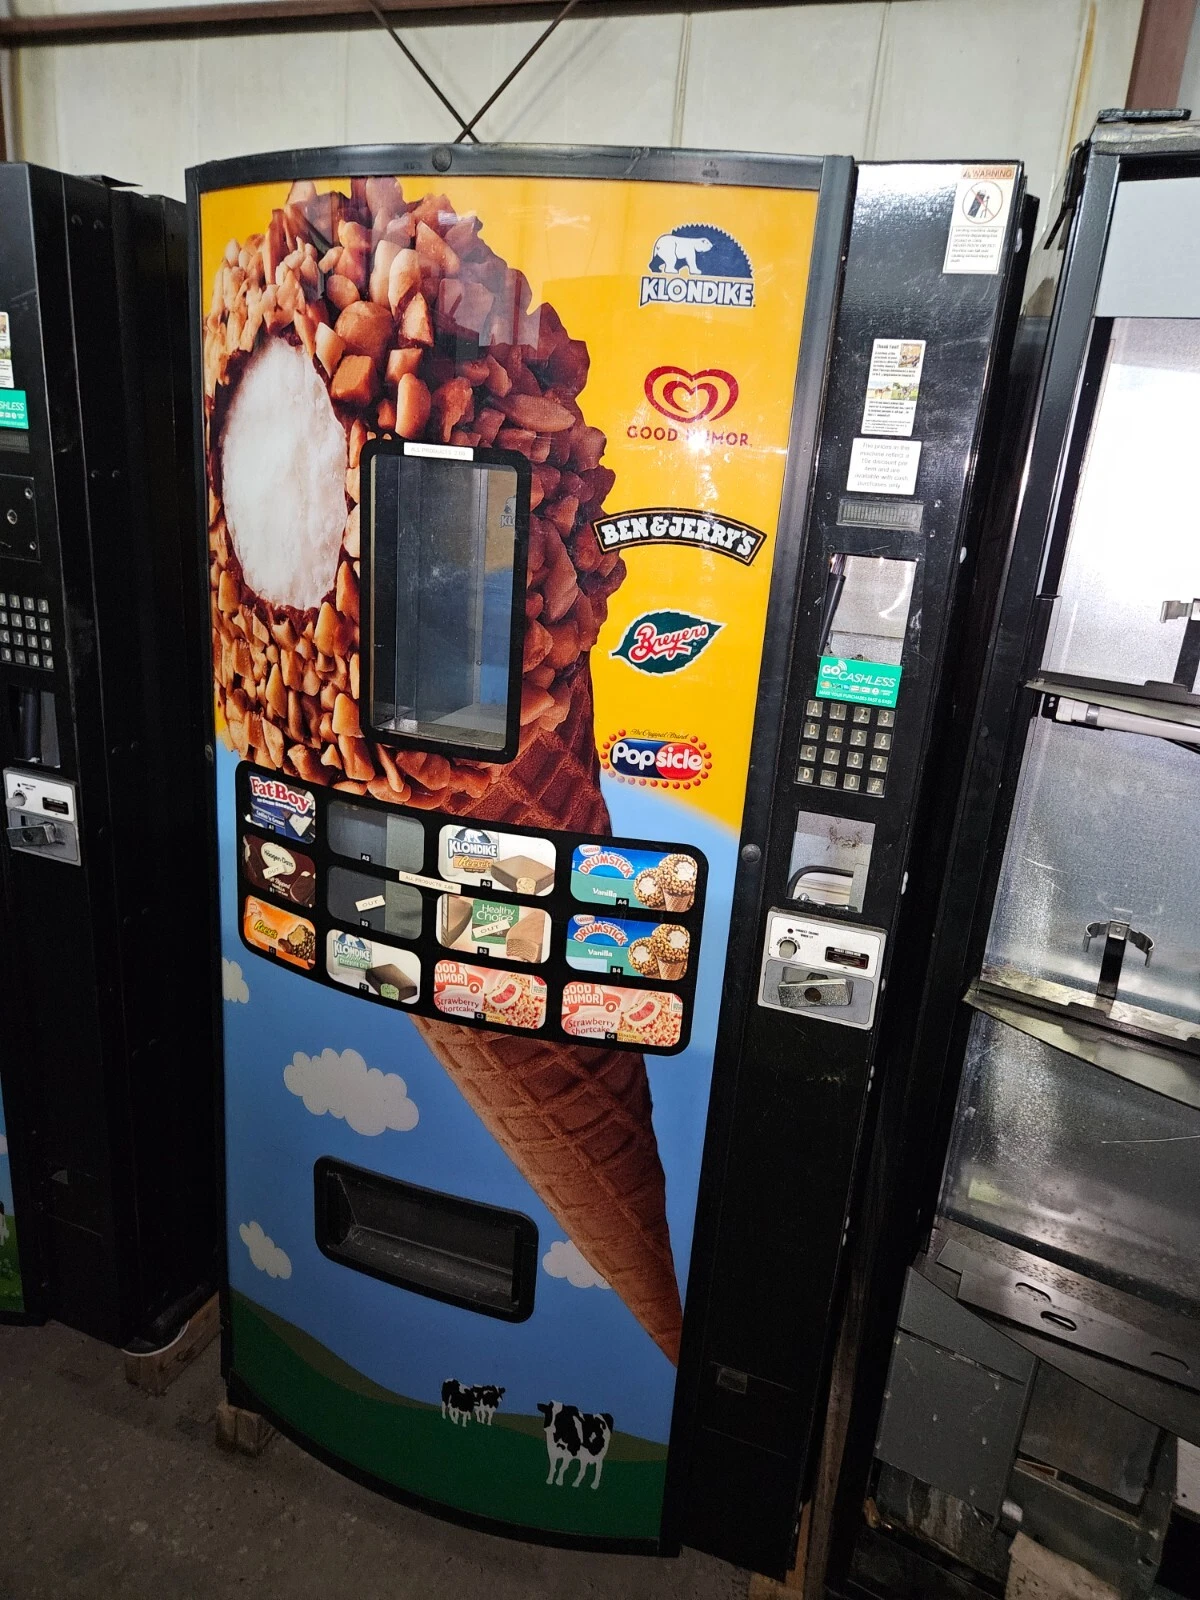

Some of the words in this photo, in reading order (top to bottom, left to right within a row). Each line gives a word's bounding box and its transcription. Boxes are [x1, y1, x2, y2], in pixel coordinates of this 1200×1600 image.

[972, 170, 1012, 178] WARNING
[640, 276, 754, 307] KLONDIKE
[627, 425, 678, 441] GOOD
[629, 624, 708, 661] Breyers
[822, 664, 841, 676] GO
[838, 671, 897, 688] CASHLESS
[612, 742, 703, 771] Popsicle
[250, 776, 311, 813] FatBoy
[448, 838, 498, 859] KLONDIKE
[458, 856, 491, 869] Reese's
[578, 854, 634, 878] DRUMSTICK
[414, 878, 442, 887] PRODUCTS
[592, 887, 617, 897] Vanilla
[362, 900, 378, 908] OUT
[481, 904, 516, 916] Healthy
[476, 910, 514, 922] Choice
[480, 925, 499, 934] OUT
[574, 923, 628, 946] DRUMSTICK
[333, 940, 371, 962] KLONDIKE
[587, 949, 613, 958] Vanilla
[436, 973, 464, 984] UMOR
[563, 985, 592, 995] GOOD
[436, 997, 480, 1009] Strawberry
[563, 994, 600, 1005] HUMOR
[568, 1018, 615, 1028] Strawberry
